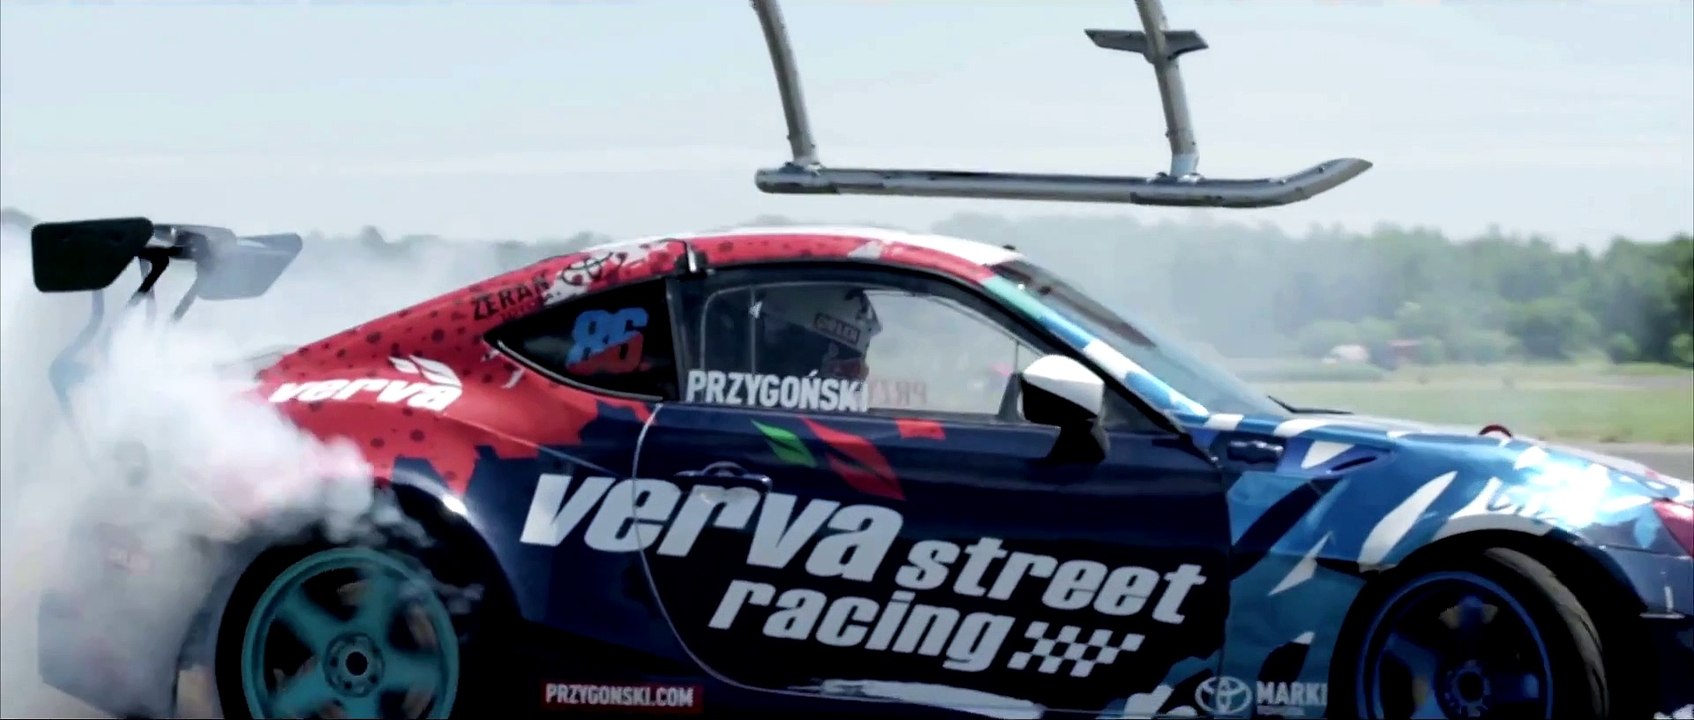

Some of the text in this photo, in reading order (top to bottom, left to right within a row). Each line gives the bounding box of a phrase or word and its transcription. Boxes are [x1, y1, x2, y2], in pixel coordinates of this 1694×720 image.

[564, 306, 649, 377] 86
[268, 378, 463, 411] verva
[686, 369, 869, 412] PRZYGOŃSKI
[519, 473, 1206, 625] verva street
[708, 579, 1016, 673] racing
[545, 683, 694, 707] PRZYGONSKI.COM
